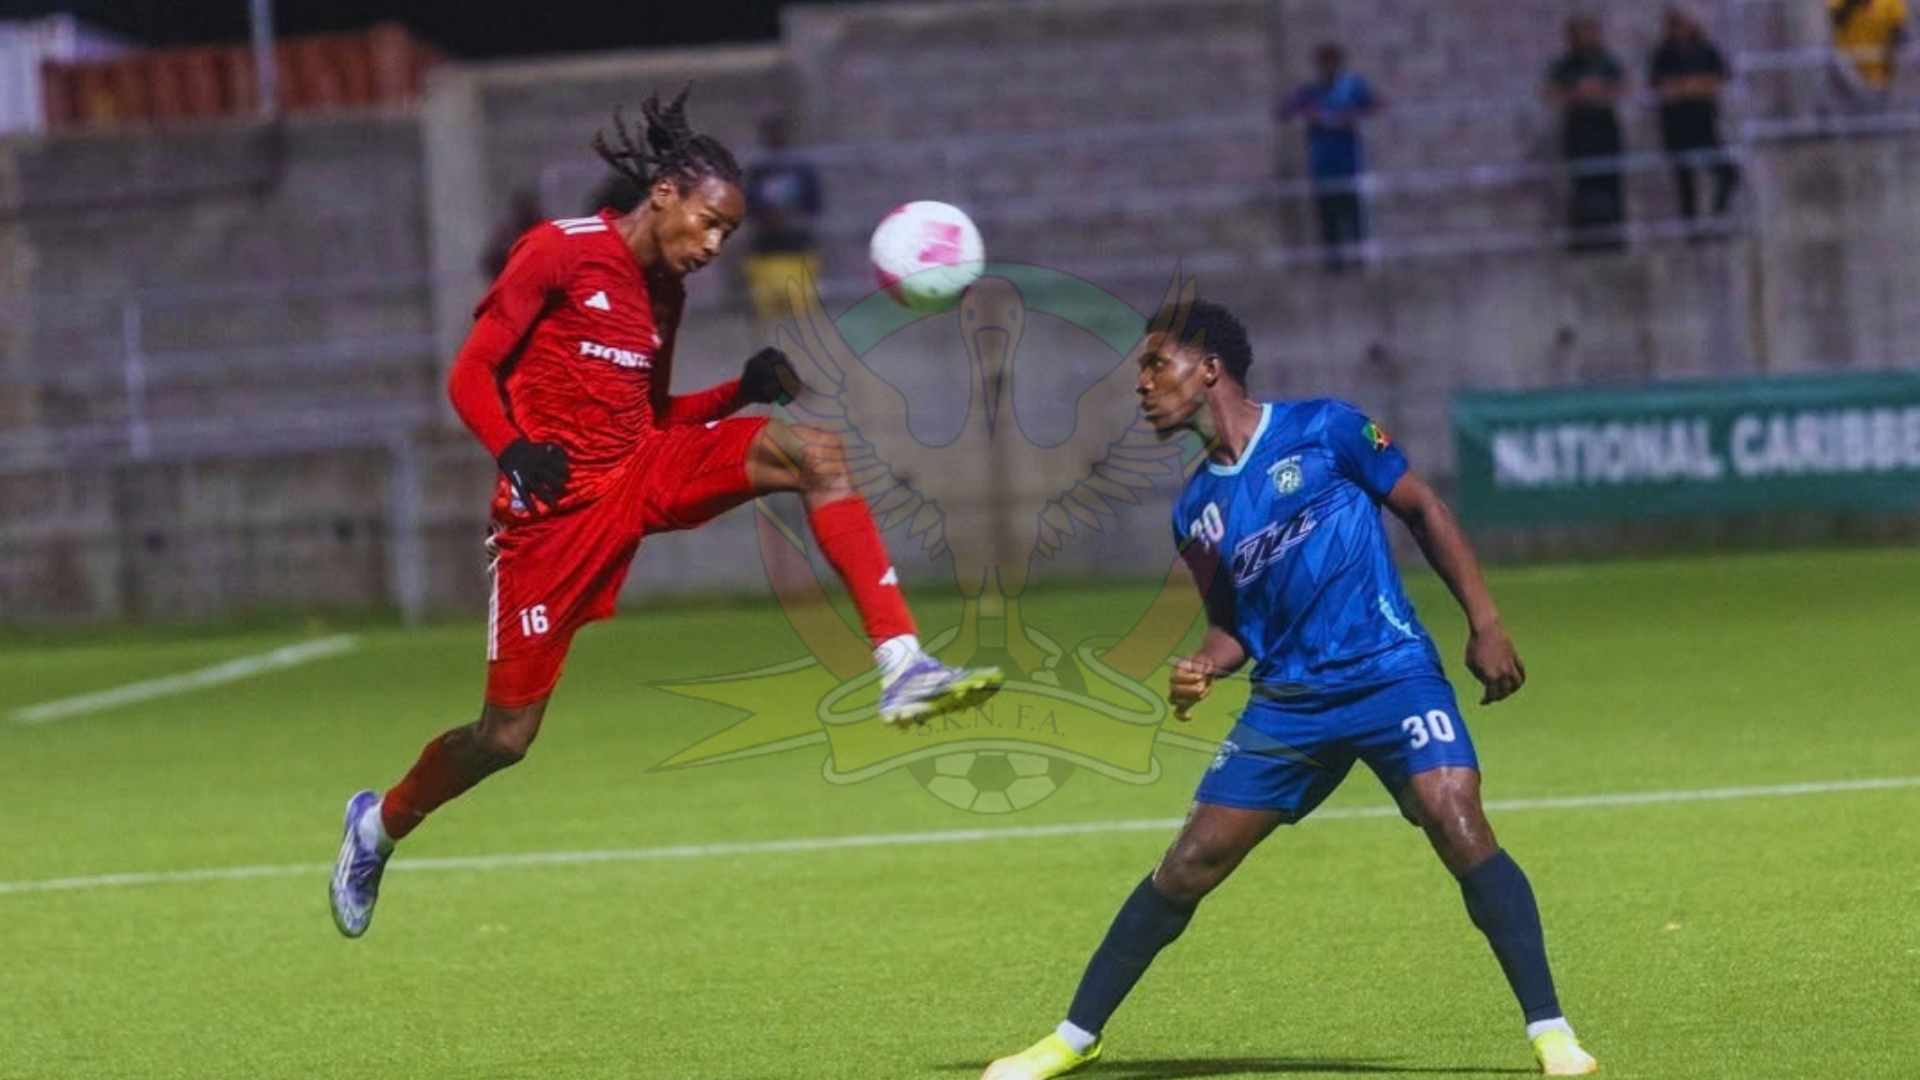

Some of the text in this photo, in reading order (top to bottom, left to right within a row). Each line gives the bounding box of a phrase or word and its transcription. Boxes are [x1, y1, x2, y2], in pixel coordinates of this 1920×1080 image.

[1494, 420, 1724, 485] NATIONAL
[519, 604, 549, 637] 16
[1402, 708, 1456, 750] 30
